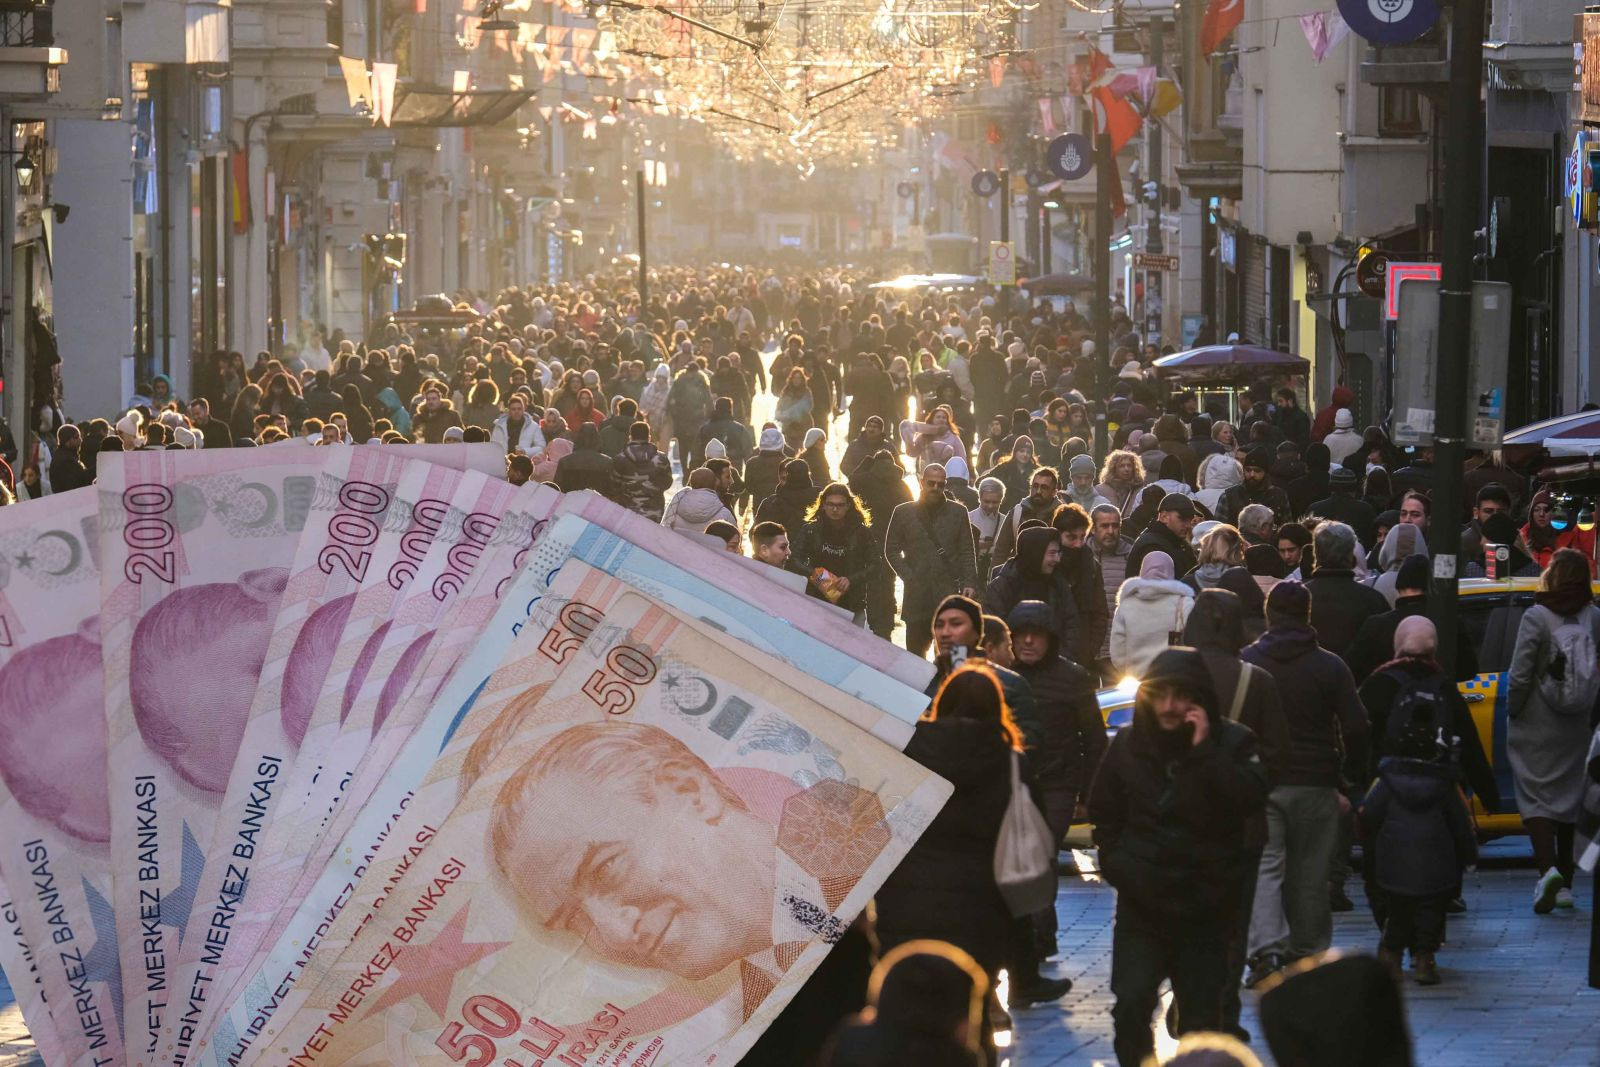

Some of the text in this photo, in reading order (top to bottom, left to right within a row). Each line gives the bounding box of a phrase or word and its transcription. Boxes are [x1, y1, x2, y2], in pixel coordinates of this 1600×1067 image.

[123, 483, 174, 584] 200
[318, 481, 390, 583] 200
[538, 602, 606, 665] 50
[581, 645, 657, 716] 50
[135, 775, 159, 881] BANKASI
[201, 864, 249, 965] MERKEZ
[232, 755, 282, 860] BANKASI
[23, 839, 75, 944] BANKASI
[140, 888, 166, 992] MERKEZ
[328, 941, 402, 1024] MERKEZ
[393, 856, 467, 944] BANKASI
[60, 947, 108, 1050] MERKEZ
[434, 994, 522, 1067] 50
[608, 1027, 632, 1050] SAYILI
